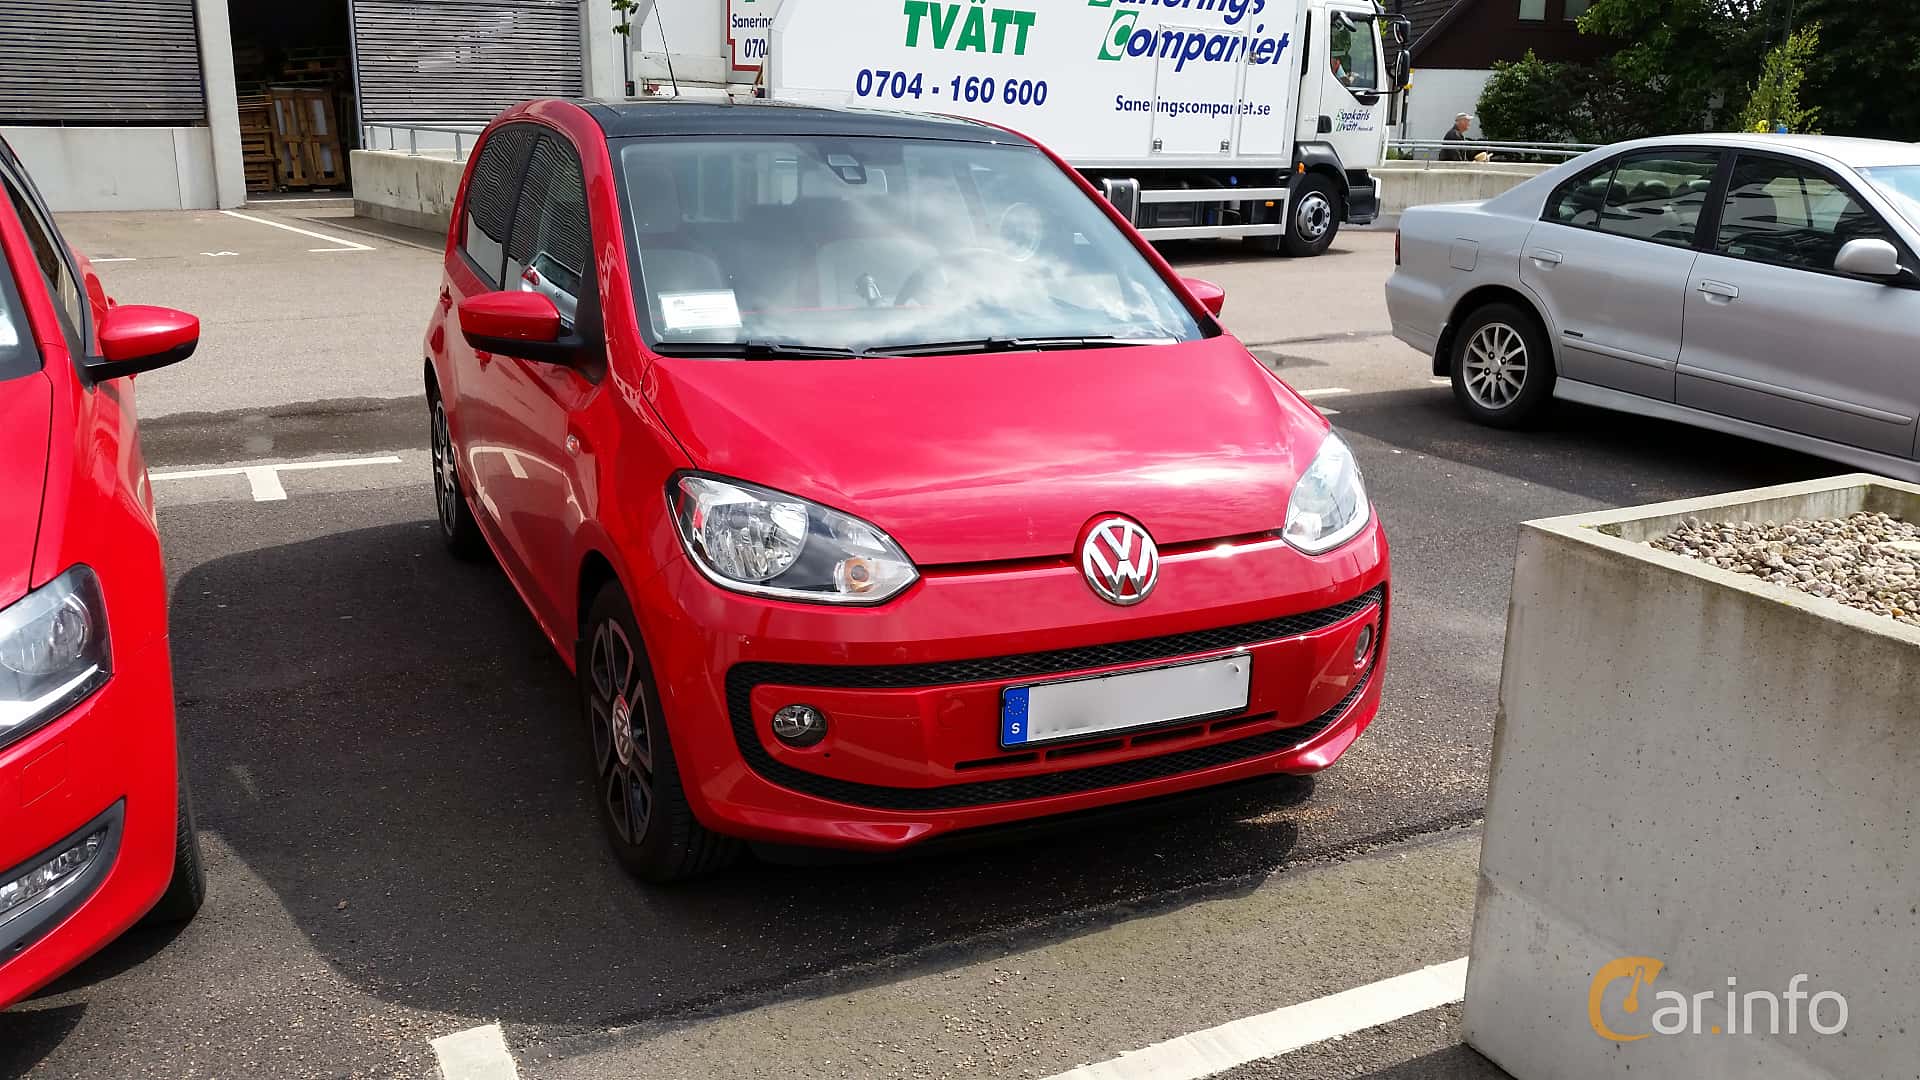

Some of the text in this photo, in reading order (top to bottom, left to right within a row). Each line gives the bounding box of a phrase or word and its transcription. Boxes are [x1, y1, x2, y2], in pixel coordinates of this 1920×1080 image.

[903, 0, 1036, 55] TVÄTT
[1098, 10, 1289, 72] Companiet
[856, 68, 923, 99] 0704
[950, 75, 995, 103] 160
[1003, 78, 1048, 105] 600
[1083, 519, 1158, 604] VW
[1011, 722, 1020, 734] S
